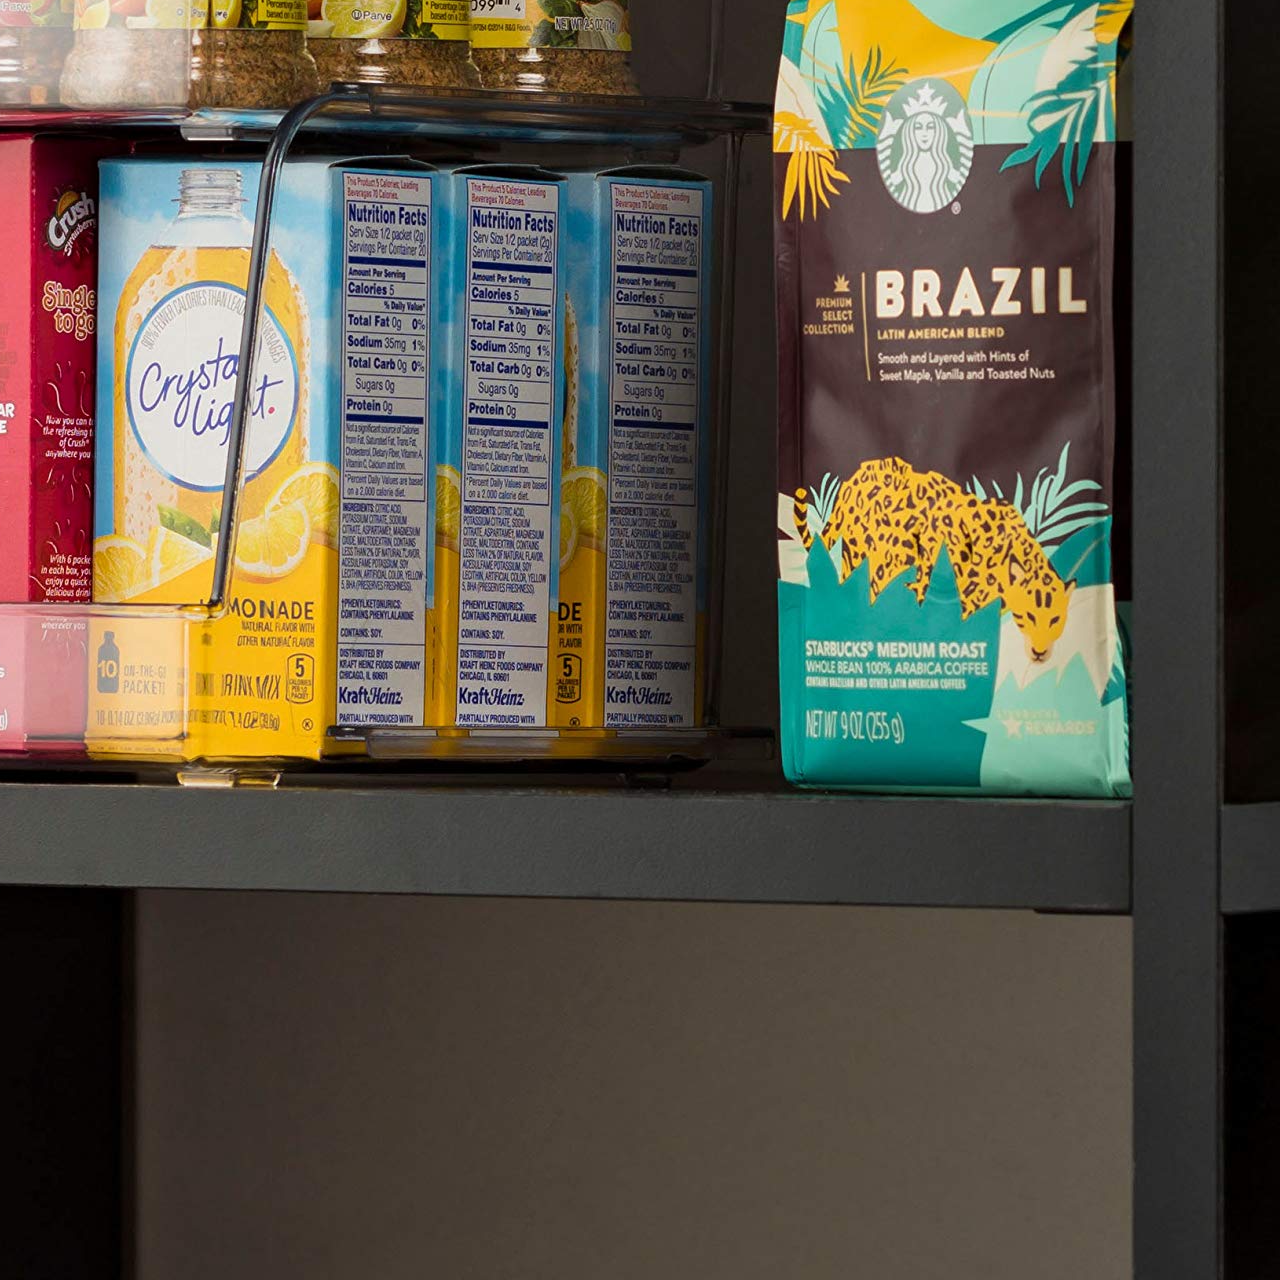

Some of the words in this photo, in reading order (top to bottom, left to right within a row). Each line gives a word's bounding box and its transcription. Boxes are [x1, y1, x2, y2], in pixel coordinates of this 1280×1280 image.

[362, 9, 393, 21] Parve
[47, 193, 95, 245] Crush
[348, 203, 396, 225] Nutrition
[398, 206, 427, 226] Facts
[616, 213, 666, 235] Nutrition
[669, 217, 698, 238] Facts
[348, 282, 387, 296] Calories
[875, 266, 1088, 318] BRAZIL
[616, 291, 657, 305] Calories
[816, 297, 853, 308] PREMIUM
[348, 314, 371, 327] Total
[374, 315, 390, 328] Fat
[822, 310, 853, 321] SELECT
[803, 323, 854, 335] COLLECTION
[877, 328, 905, 340] LATIN
[907, 327, 964, 340] AMERICAN
[967, 327, 1005, 339] BLEND
[347, 335, 382, 349] Sodium
[384, 337, 406, 353] 35mg
[878, 351, 909, 365] Smooth
[928, 350, 964, 365] Layered
[966, 350, 987, 363] with
[989, 350, 1016, 363] Hints
[879, 370, 903, 382] Sweet
[935, 368, 964, 381] Vanilla
[987, 368, 1027, 380] Toasted
[1029, 367, 1055, 380] Nuts
[355, 377, 383, 392] Sugars
[346, 399, 381, 412] Protein
[614, 404, 650, 419] Protein
[877, 642, 935, 658] MEDIUM
[939, 642, 987, 658] ROAST
[295, 657, 305, 677] 5
[805, 660, 836, 675] WHOLE
[837, 661, 863, 675] BEAN
[894, 662, 942, 676] ARABICA
[944, 662, 988, 676] COFFEE
[806, 710, 823, 738] NET
[849, 712, 865, 739] OZ
